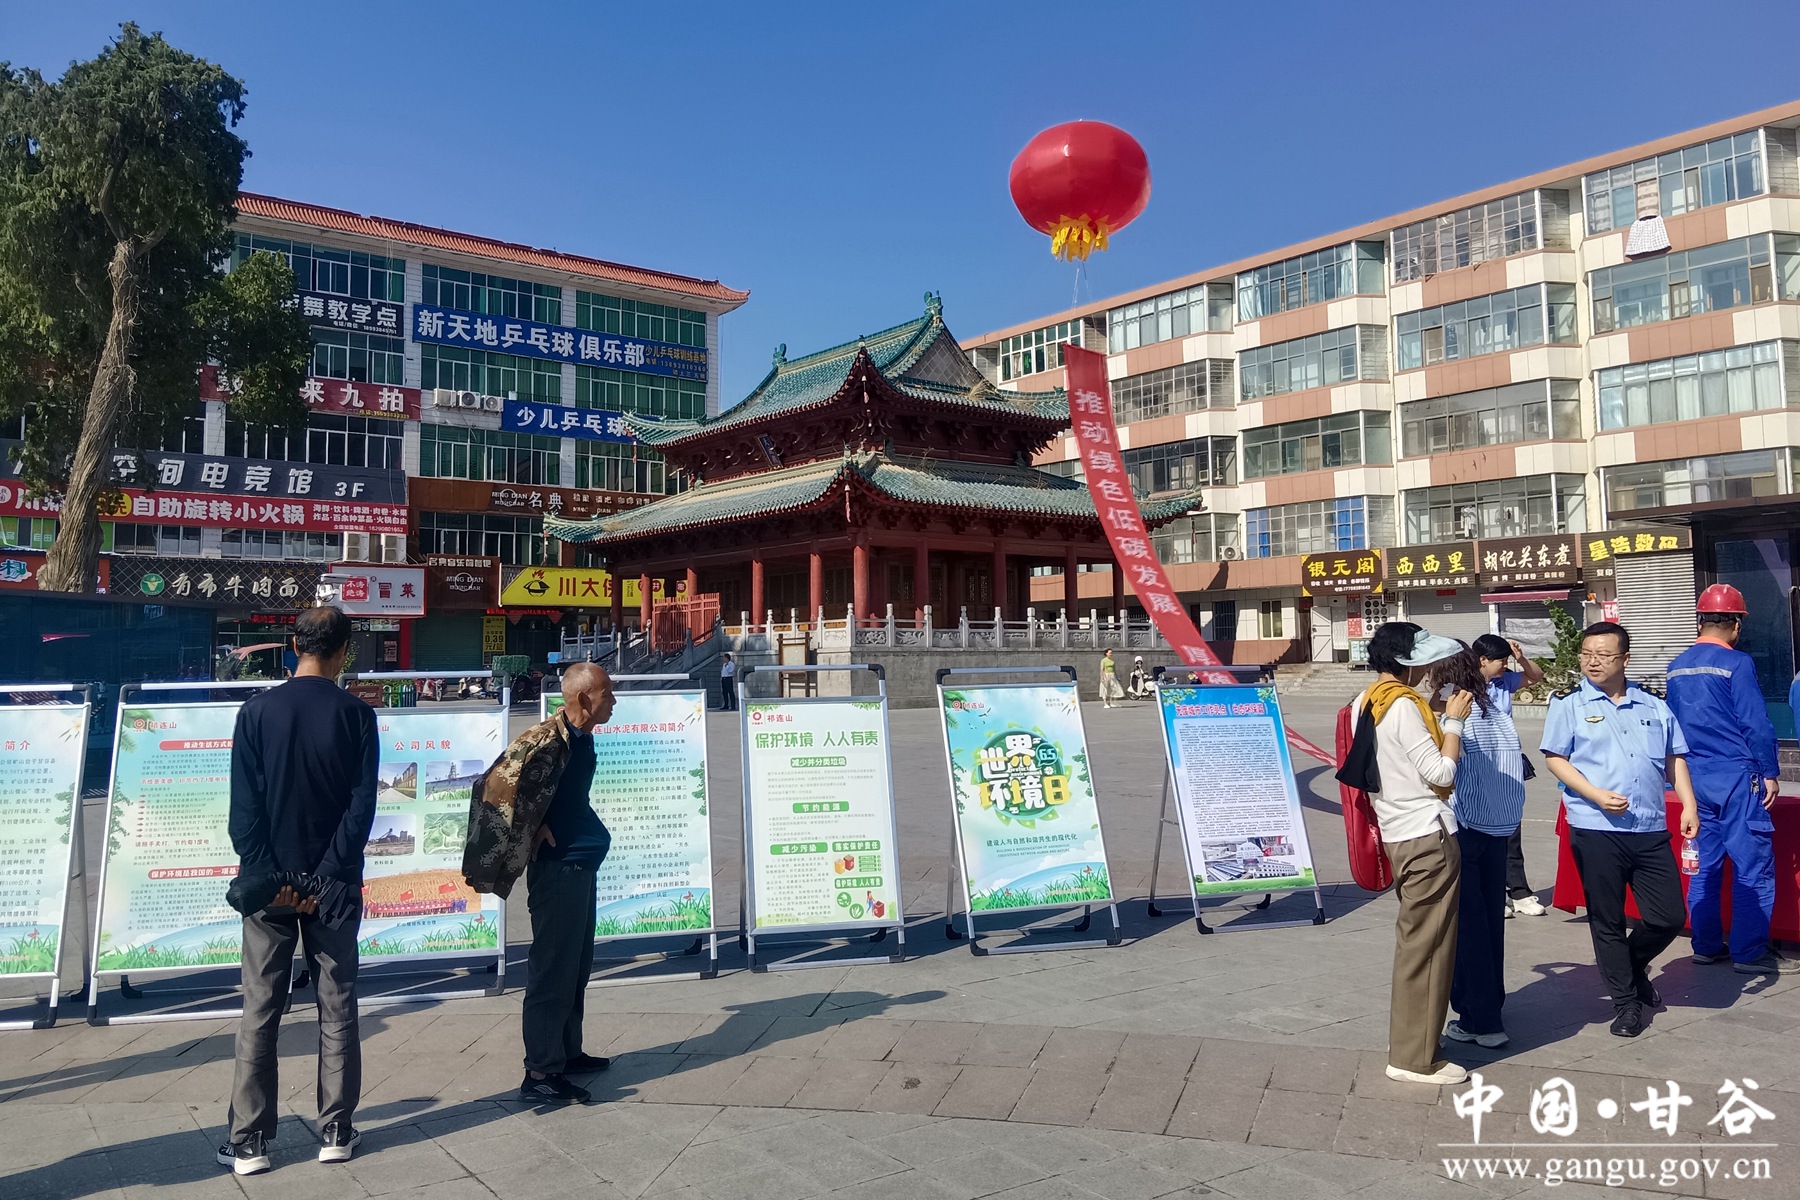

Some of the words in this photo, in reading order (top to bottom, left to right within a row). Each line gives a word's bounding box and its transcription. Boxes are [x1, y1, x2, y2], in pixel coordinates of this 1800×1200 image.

[418, 310, 644, 367] 新天地乒乓球俱乐部
[517, 406, 627, 436] 少儿乒乓球
[335, 482, 365, 498] 3F
[528, 491, 563, 510] 名典
[1073, 388, 1181, 616] 推动绿色低碳发展
[132, 496, 305, 525] 自助旋转小火锅
[1396, 551, 1466, 575] 西西里
[1483, 543, 1571, 572] 胡记关东煮
[1307, 557, 1375, 578] 银元阁
[378, 582, 416, 599] 冒菜
[767, 714, 793, 722] 祁连山
[593, 721, 686, 735] 连山水泥有限公司简介
[4, 740, 31, 751] 简介
[394, 739, 452, 751] 公司风貌
[755, 731, 814, 749] 保护环境
[823, 730, 879, 747] 人人有责
[802, 803, 841, 812] 节约能源
[835, 841, 879, 851] 落实保护责任
[986, 833, 1078, 847] 建设人与自然和谐共生的现代化
[781, 844, 817, 853] 减少污染
[151, 867, 240, 879] 保护环境是我国的一项基
